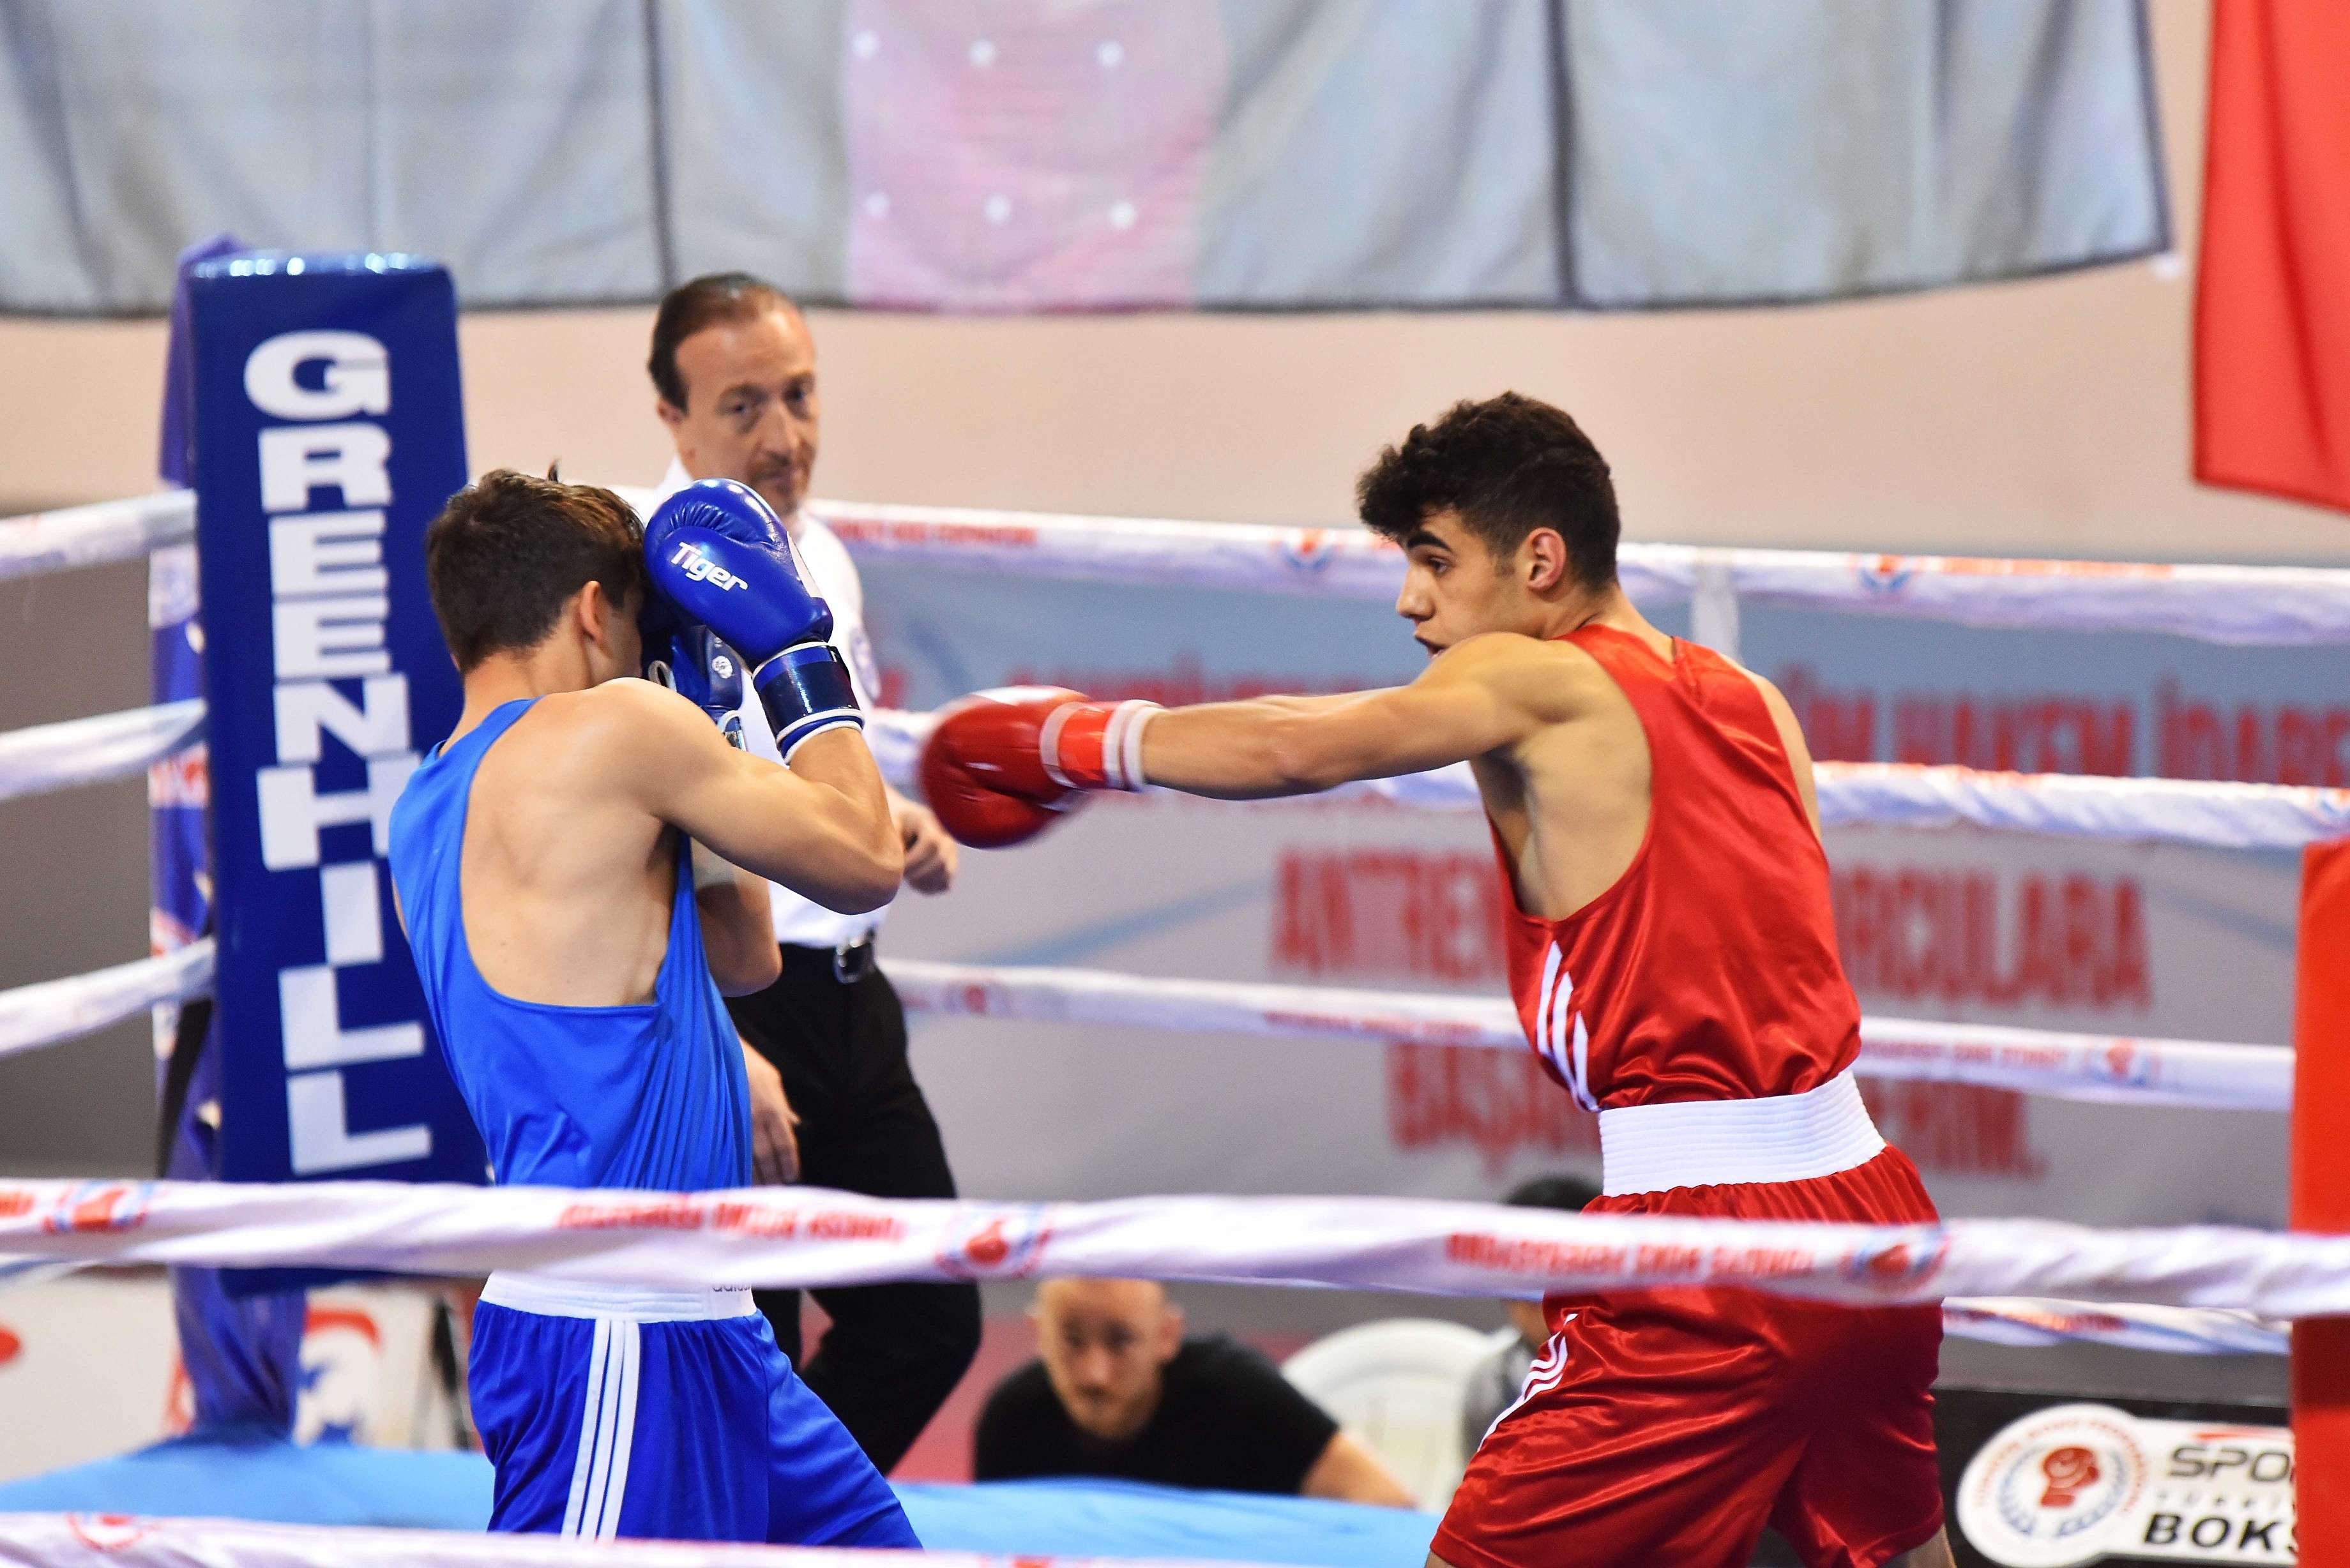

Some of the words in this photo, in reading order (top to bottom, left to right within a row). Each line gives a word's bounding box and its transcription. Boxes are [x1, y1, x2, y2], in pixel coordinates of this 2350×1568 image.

[671, 541, 748, 591] Tiger
[243, 329, 432, 1176] GREENHILL
[2170, 1444, 2293, 1482] SPO
[2143, 1512, 2298, 1553] BOK
